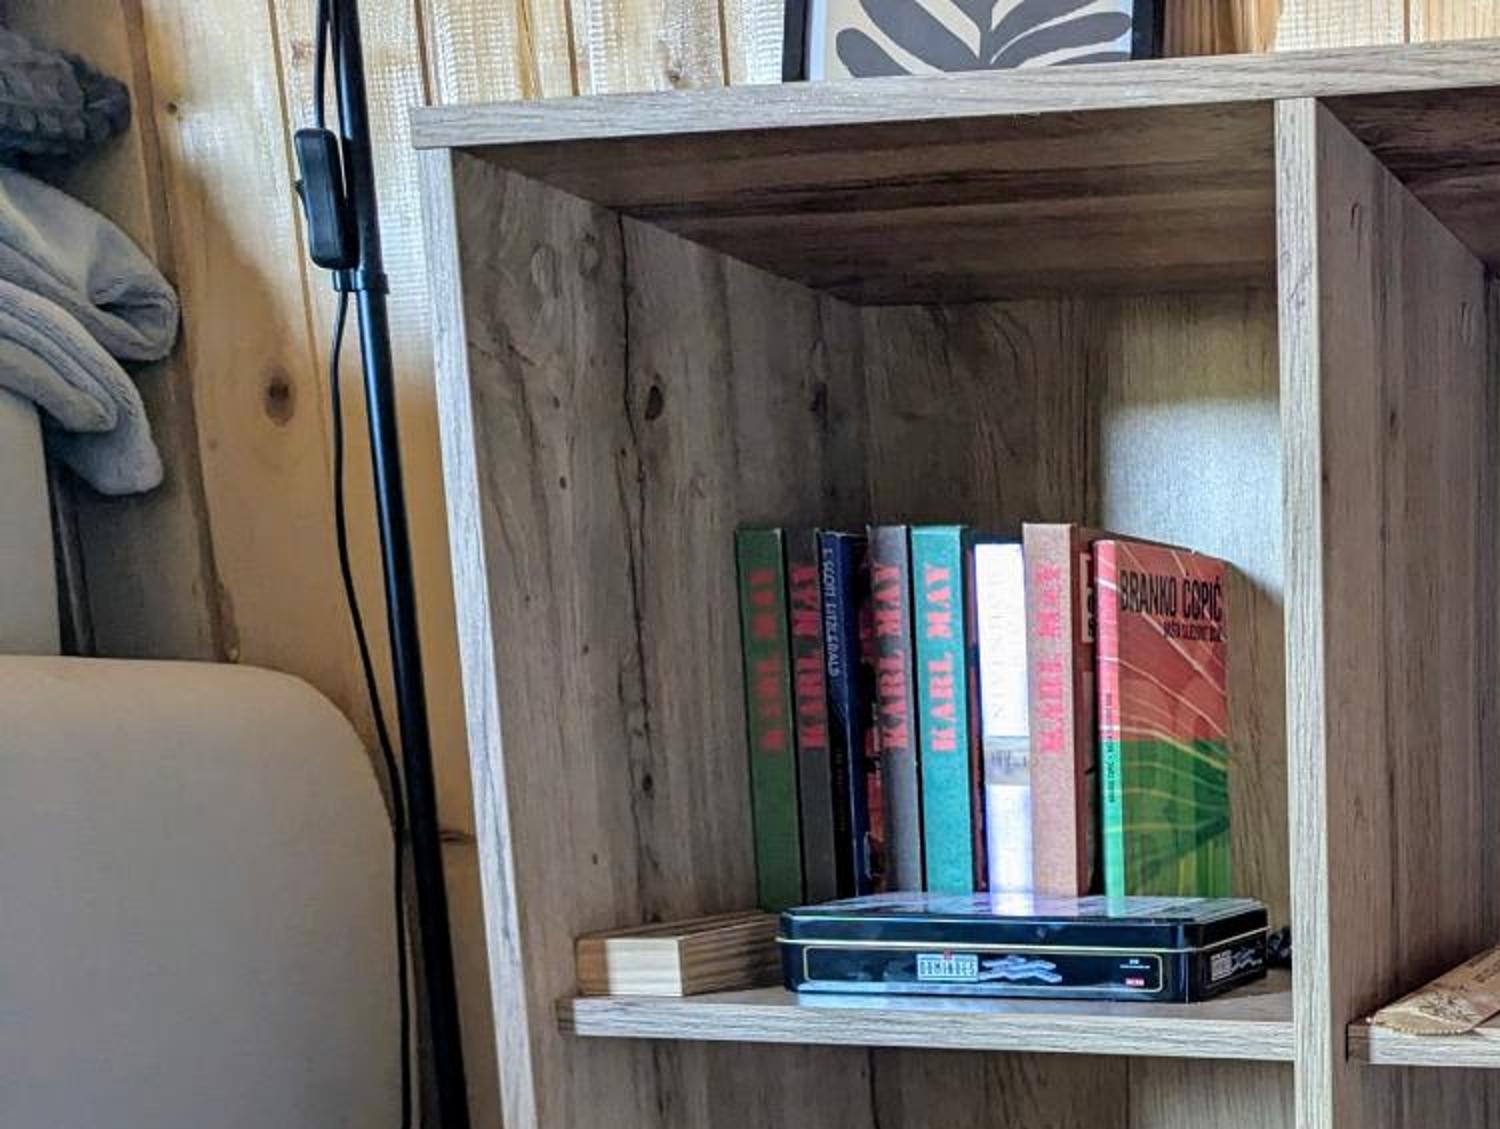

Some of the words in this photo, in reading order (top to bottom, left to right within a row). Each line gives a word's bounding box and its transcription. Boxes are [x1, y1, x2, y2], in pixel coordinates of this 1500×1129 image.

[791, 563, 819, 637] MAY
[870, 561, 902, 637] MAY
[924, 561, 952, 639] MAY
[1120, 570, 1177, 617] BRANKO
[797, 652, 827, 749] KARL
[877, 647, 908, 751] KARL
[927, 650, 957, 751] KARL
[1034, 651, 1065, 752] KARL
